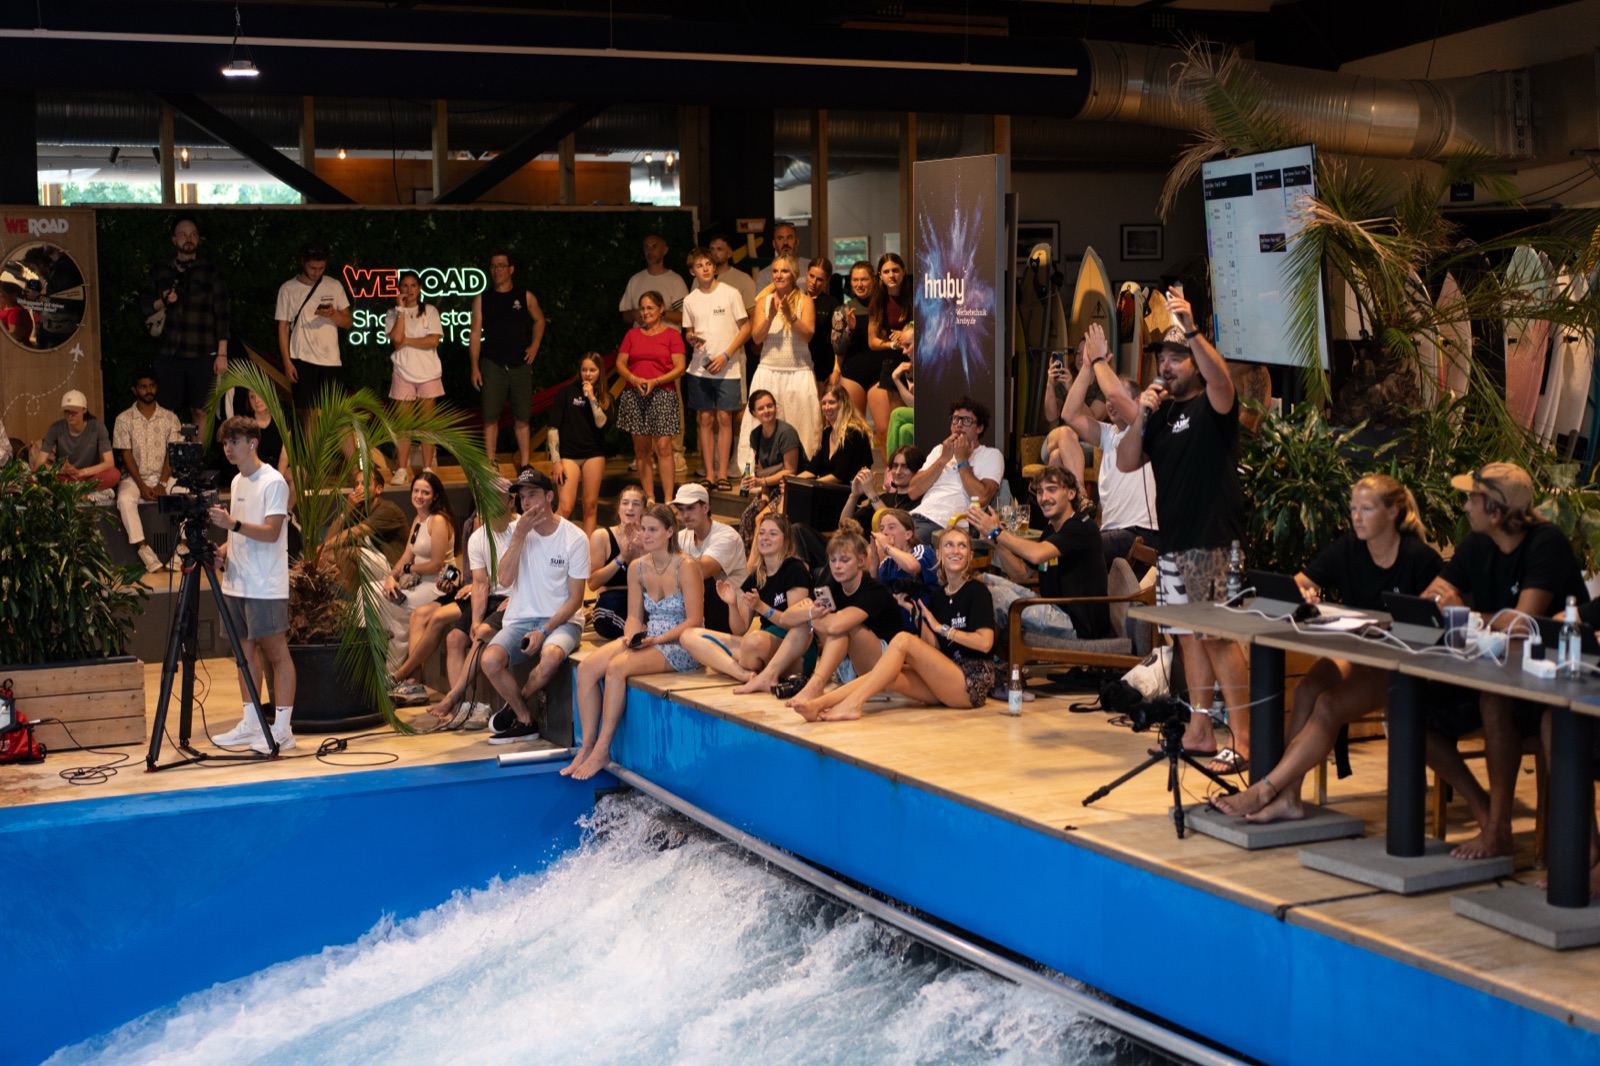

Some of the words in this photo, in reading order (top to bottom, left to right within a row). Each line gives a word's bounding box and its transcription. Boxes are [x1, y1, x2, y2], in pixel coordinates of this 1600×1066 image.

[4, 216, 69, 237] WEROAD
[924, 271, 965, 305] hruby
[441, 309, 472, 326] sta
[349, 330, 371, 345] or
